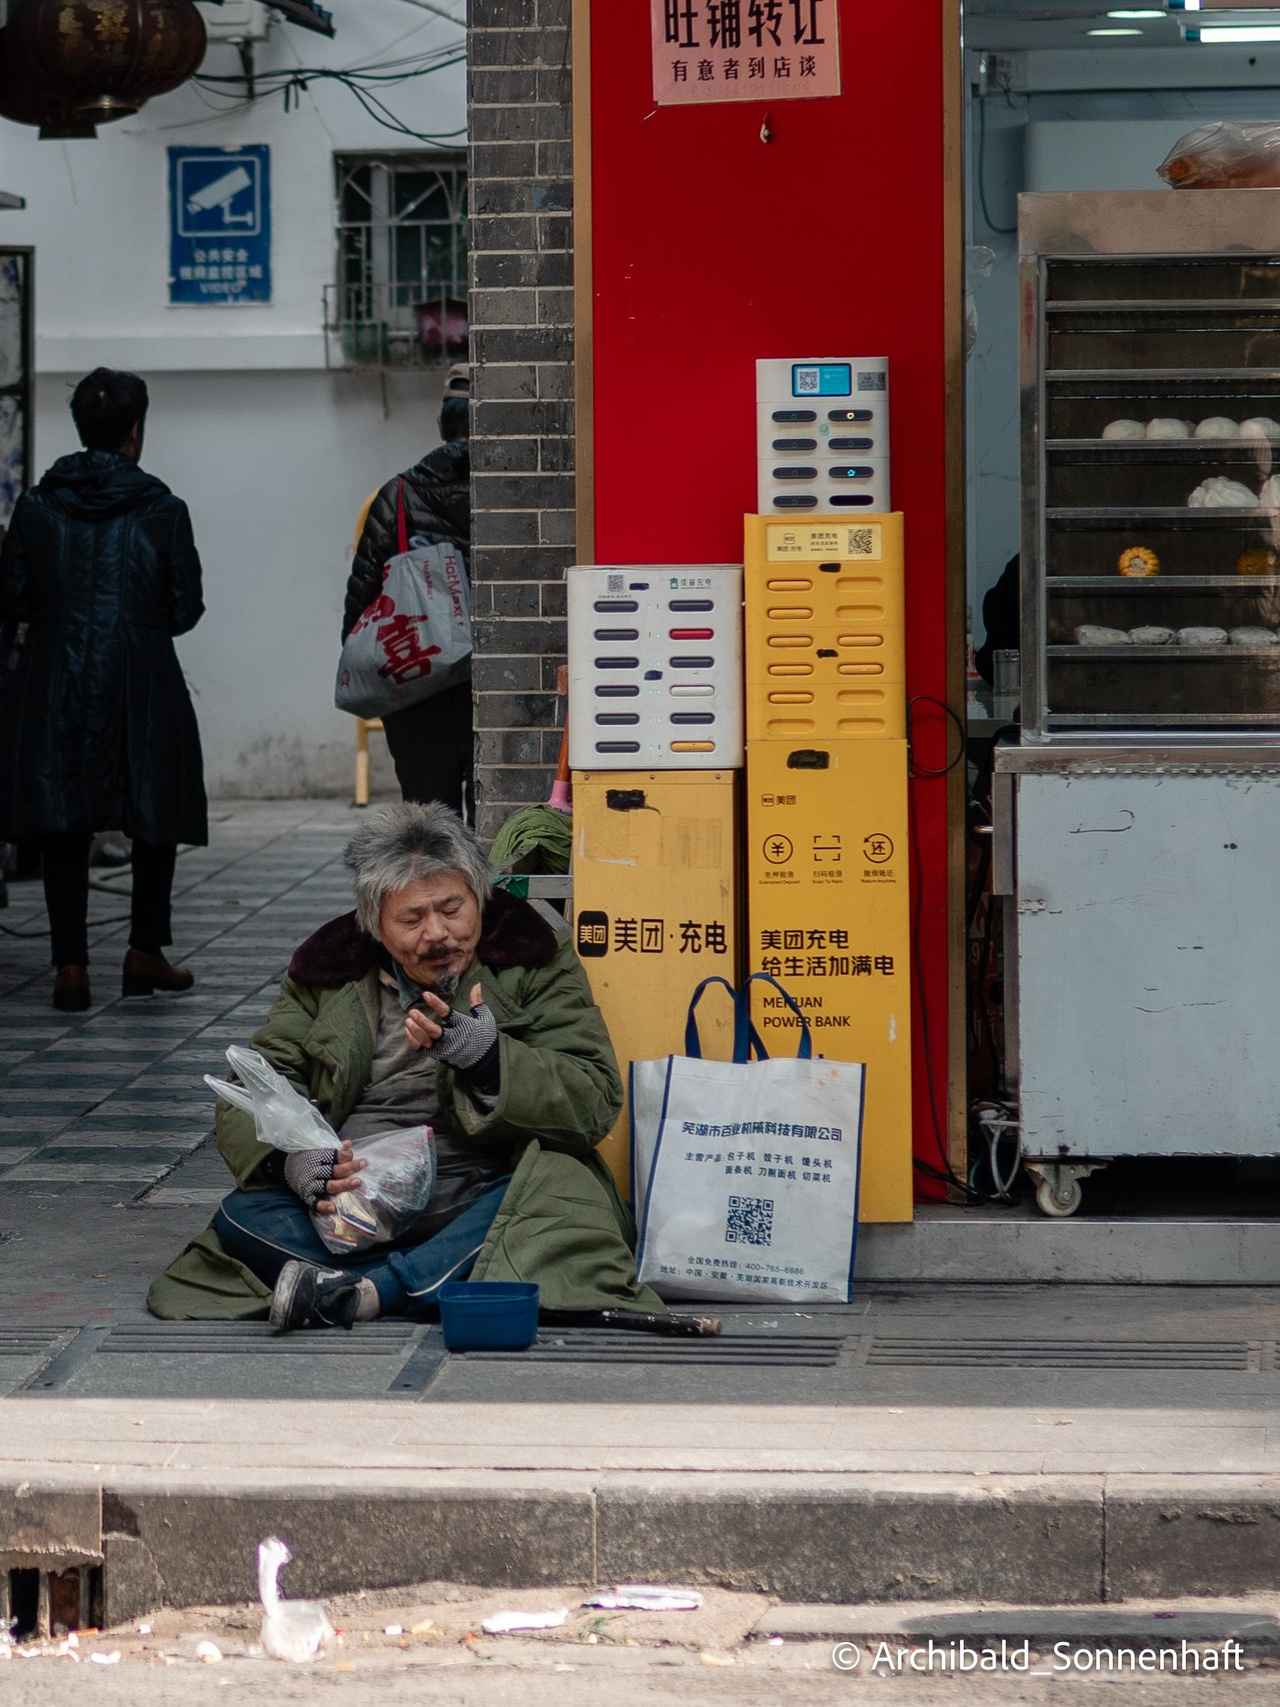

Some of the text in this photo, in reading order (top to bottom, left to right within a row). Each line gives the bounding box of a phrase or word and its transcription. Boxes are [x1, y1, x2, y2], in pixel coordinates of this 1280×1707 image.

[664, 0, 825, 48] 旺铺转让
[671, 55, 817, 82] 有意者到店谈
[580, 925, 606, 944] 美团
[761, 929, 849, 950] 美团充电
[761, 955, 895, 977] 给生活加满电
[763, 1016, 851, 1027] POWER BANK
